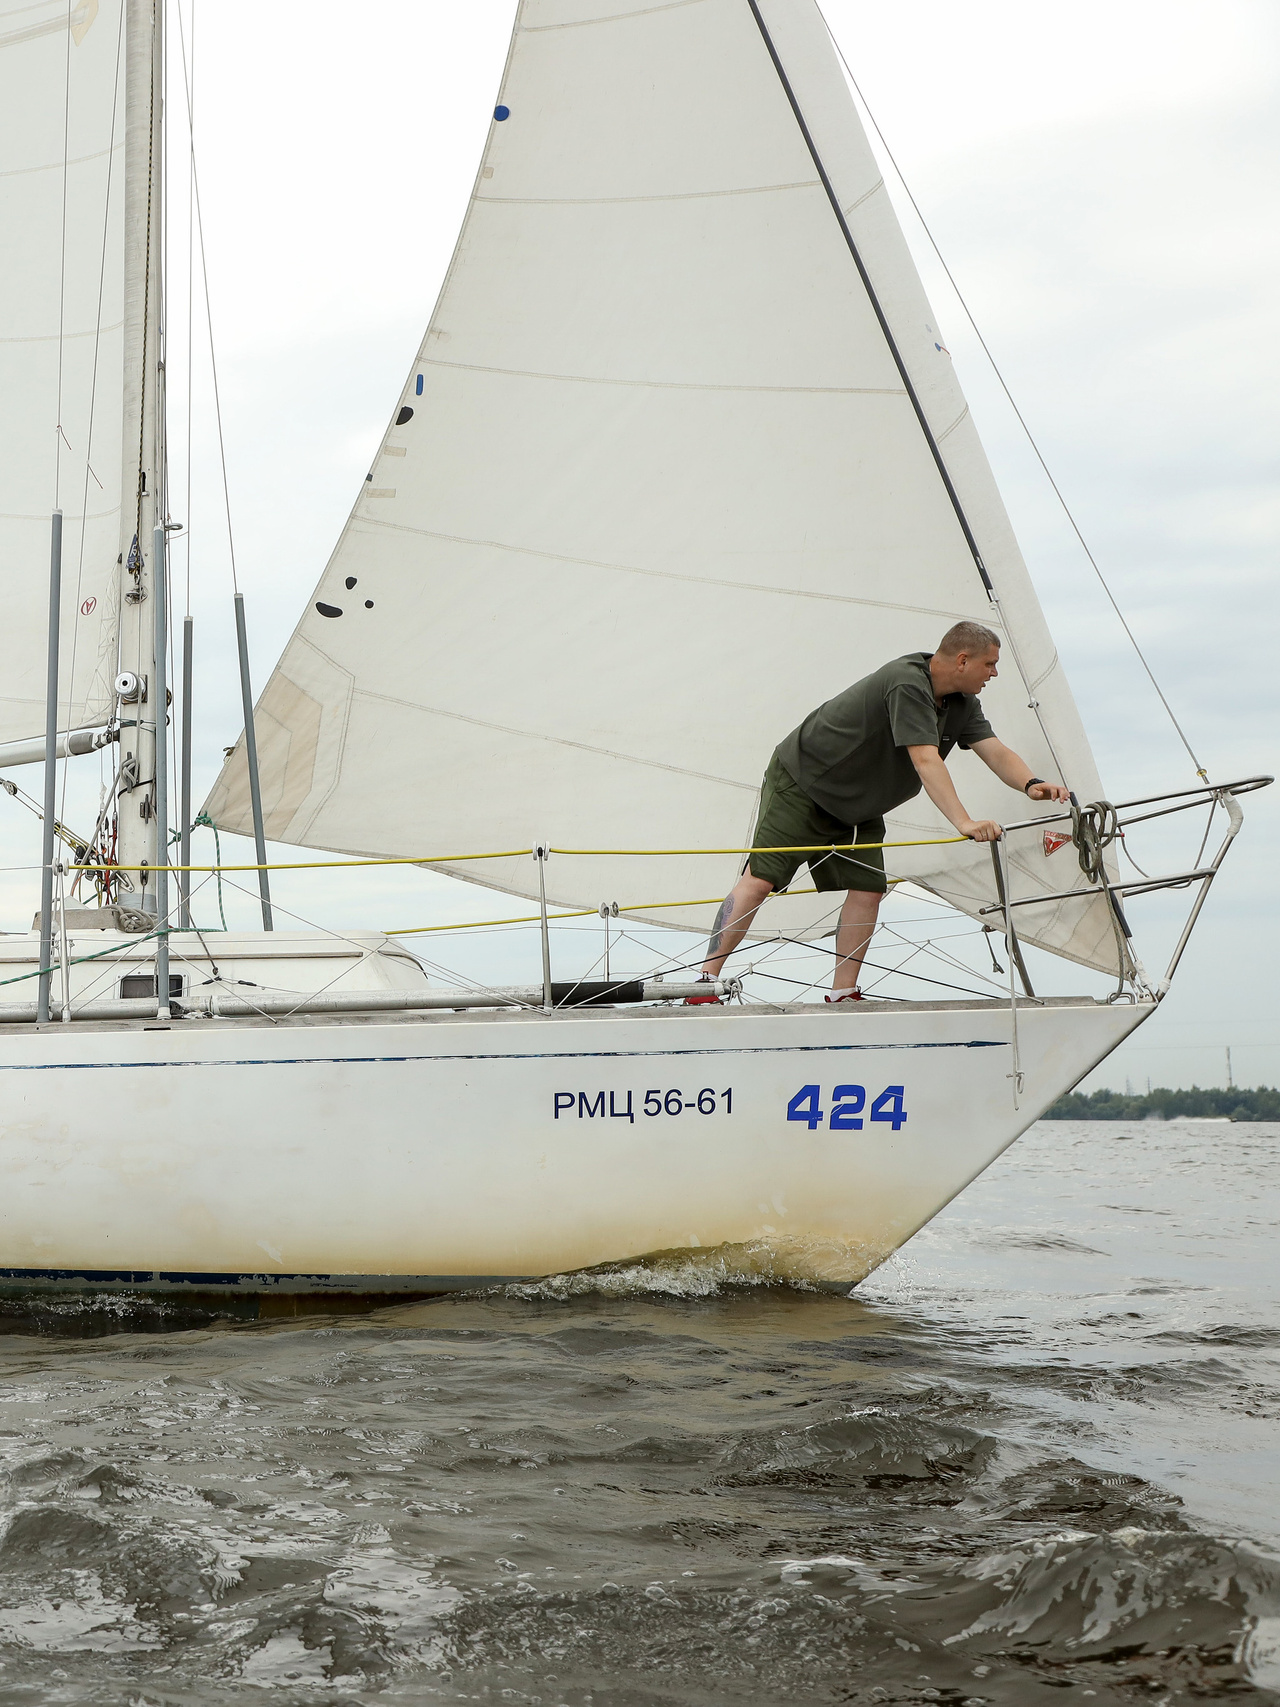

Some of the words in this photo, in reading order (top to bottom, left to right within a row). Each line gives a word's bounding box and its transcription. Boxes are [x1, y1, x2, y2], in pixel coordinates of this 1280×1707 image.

[553, 1090, 635, 1124] РМЦ
[643, 1087, 734, 1118] 56-61
[786, 1084, 908, 1131] 424
